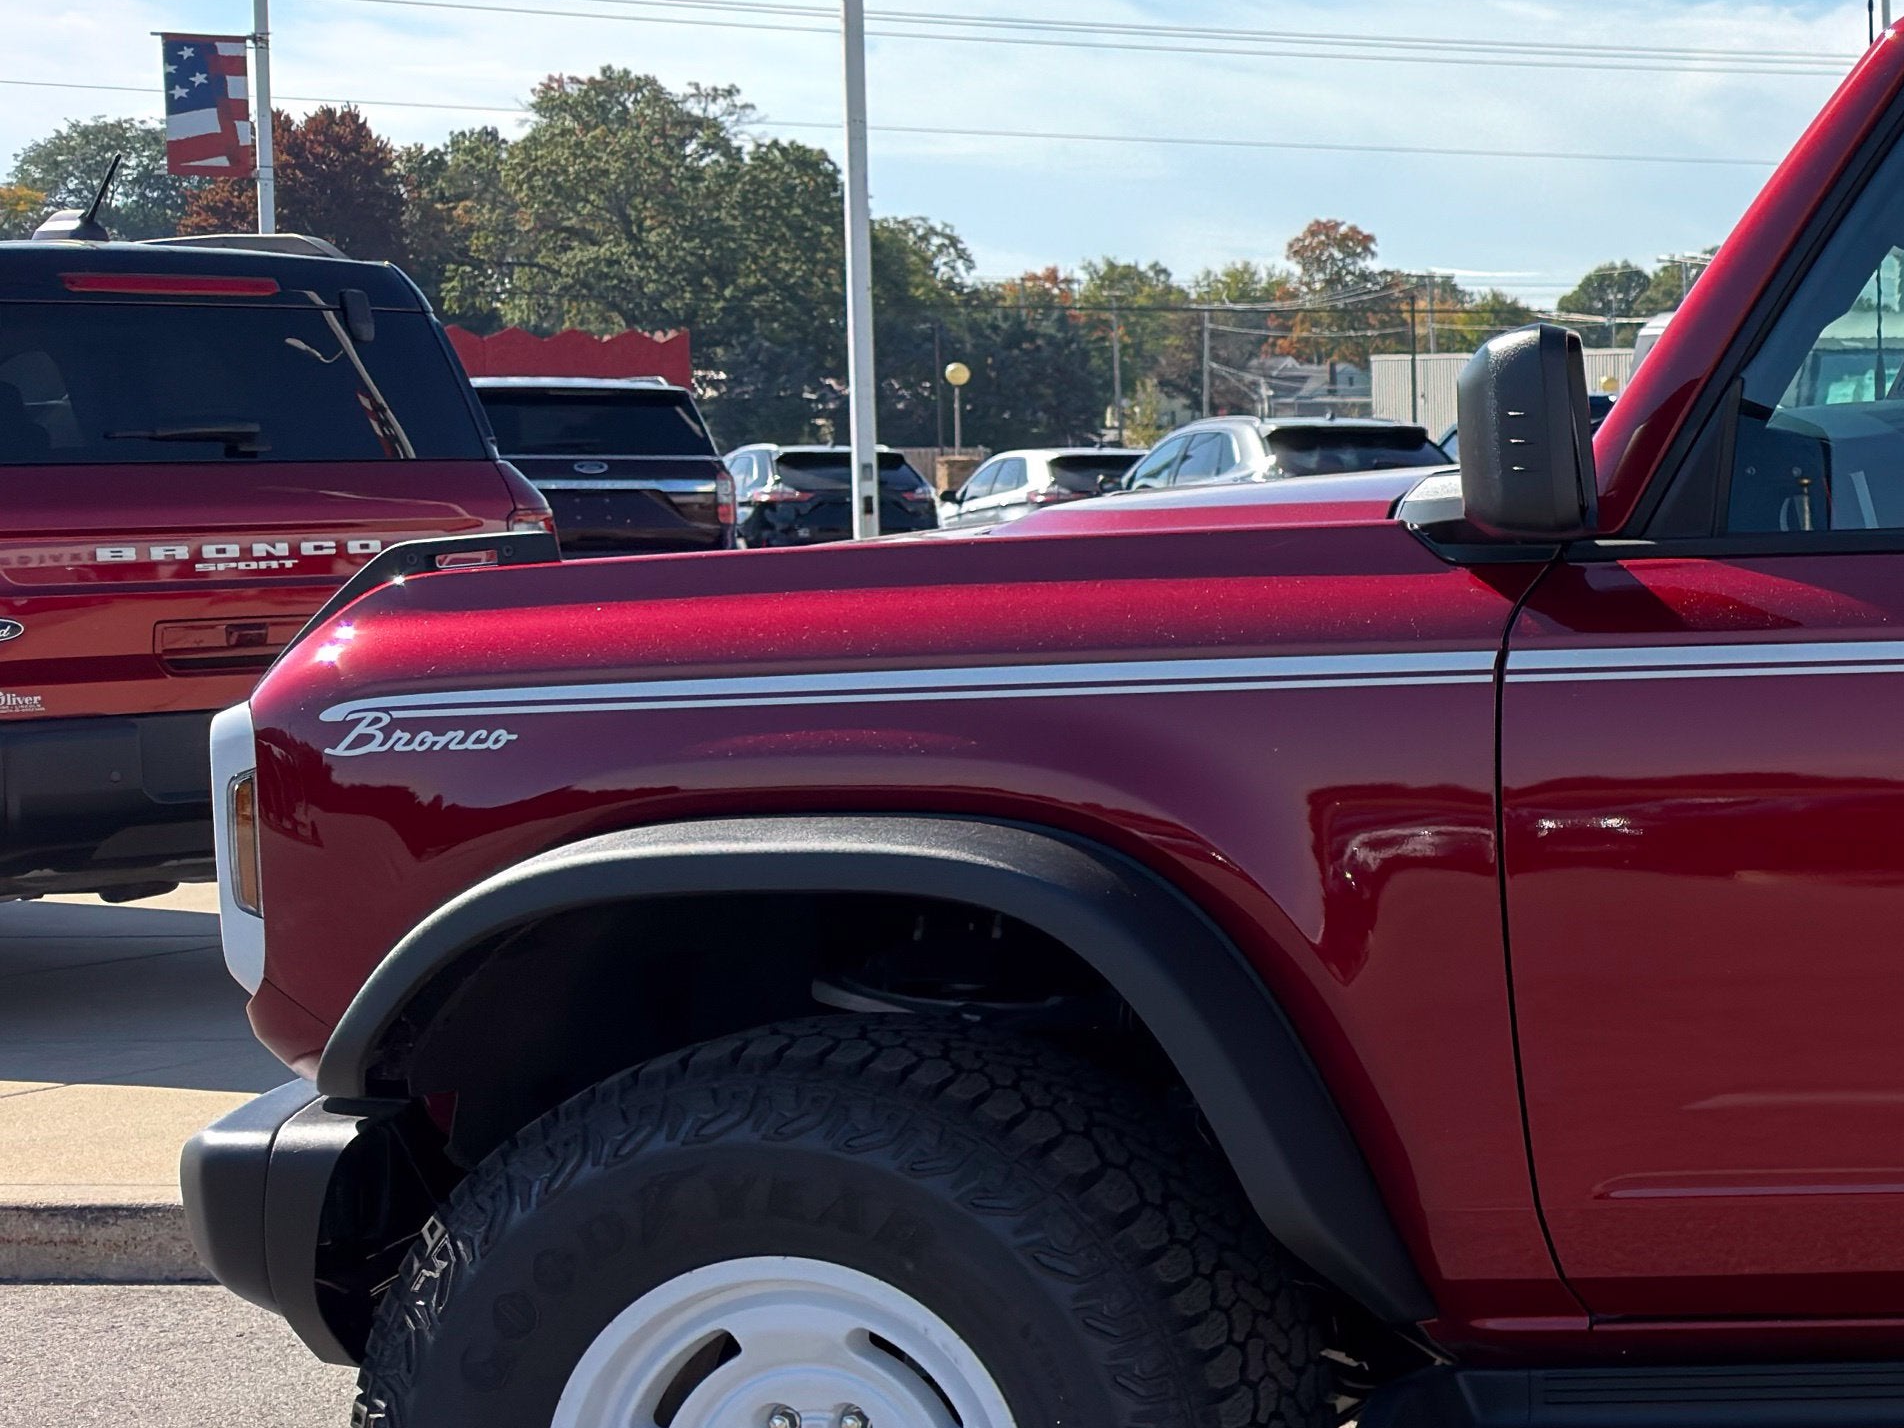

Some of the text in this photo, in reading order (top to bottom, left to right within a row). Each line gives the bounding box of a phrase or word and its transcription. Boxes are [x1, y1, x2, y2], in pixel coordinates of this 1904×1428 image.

[95, 539, 381, 562] BRONCO
[195, 559, 299, 572] SPORT
[323, 710, 518, 756] Bronco
